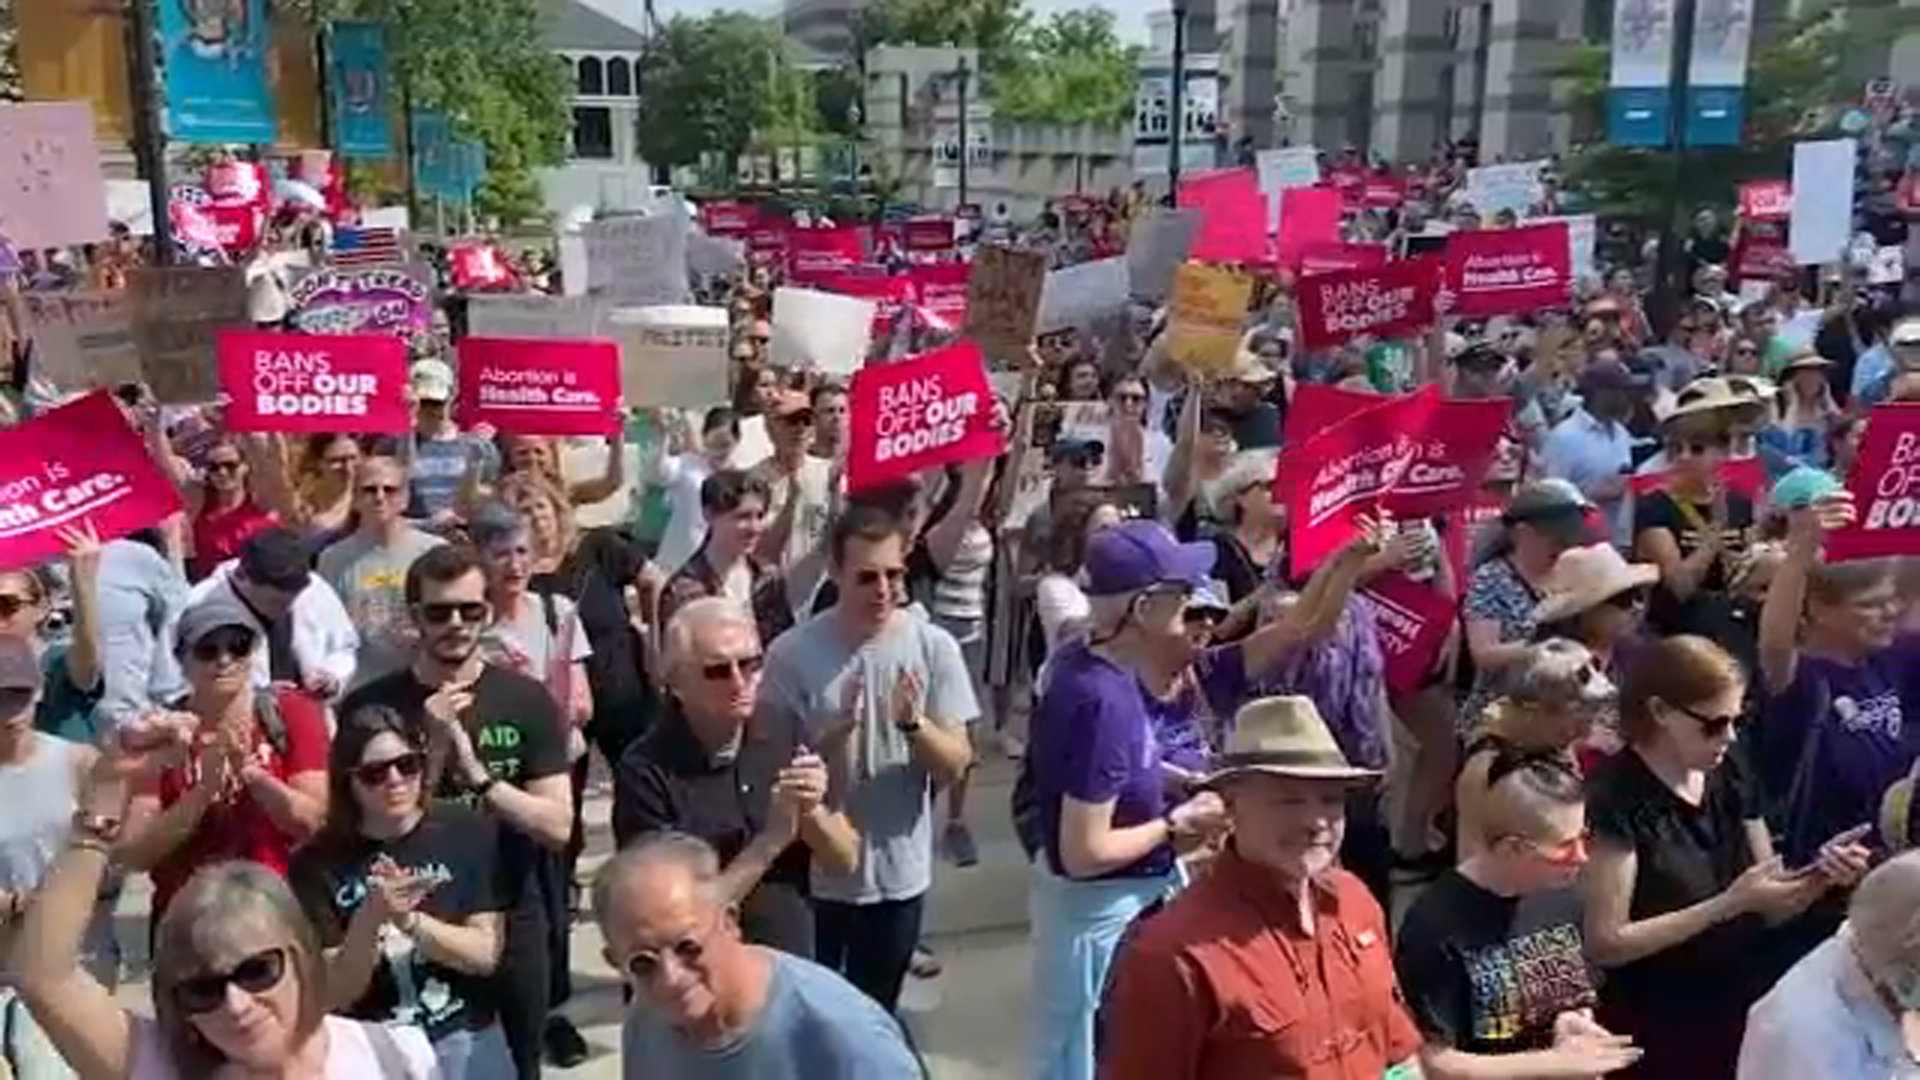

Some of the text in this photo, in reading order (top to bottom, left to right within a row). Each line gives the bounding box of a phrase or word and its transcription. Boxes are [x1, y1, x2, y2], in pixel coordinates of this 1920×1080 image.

[1319, 278, 1380, 302] BANS
[1324, 302, 1408, 335] BODIES
[254, 350, 332, 373] BANS
[253, 371, 378, 395] OFF OUR
[479, 366, 578, 385] Abortion is
[256, 393, 368, 416] BODIES
[479, 384, 549, 404] Health
[878, 373, 943, 413] BANS
[875, 391, 978, 436] OFF OUR
[874, 418, 966, 462] BODIES
[41, 459, 71, 483] is
[41, 471, 126, 512] Care.
[477, 725, 521, 749] AID
